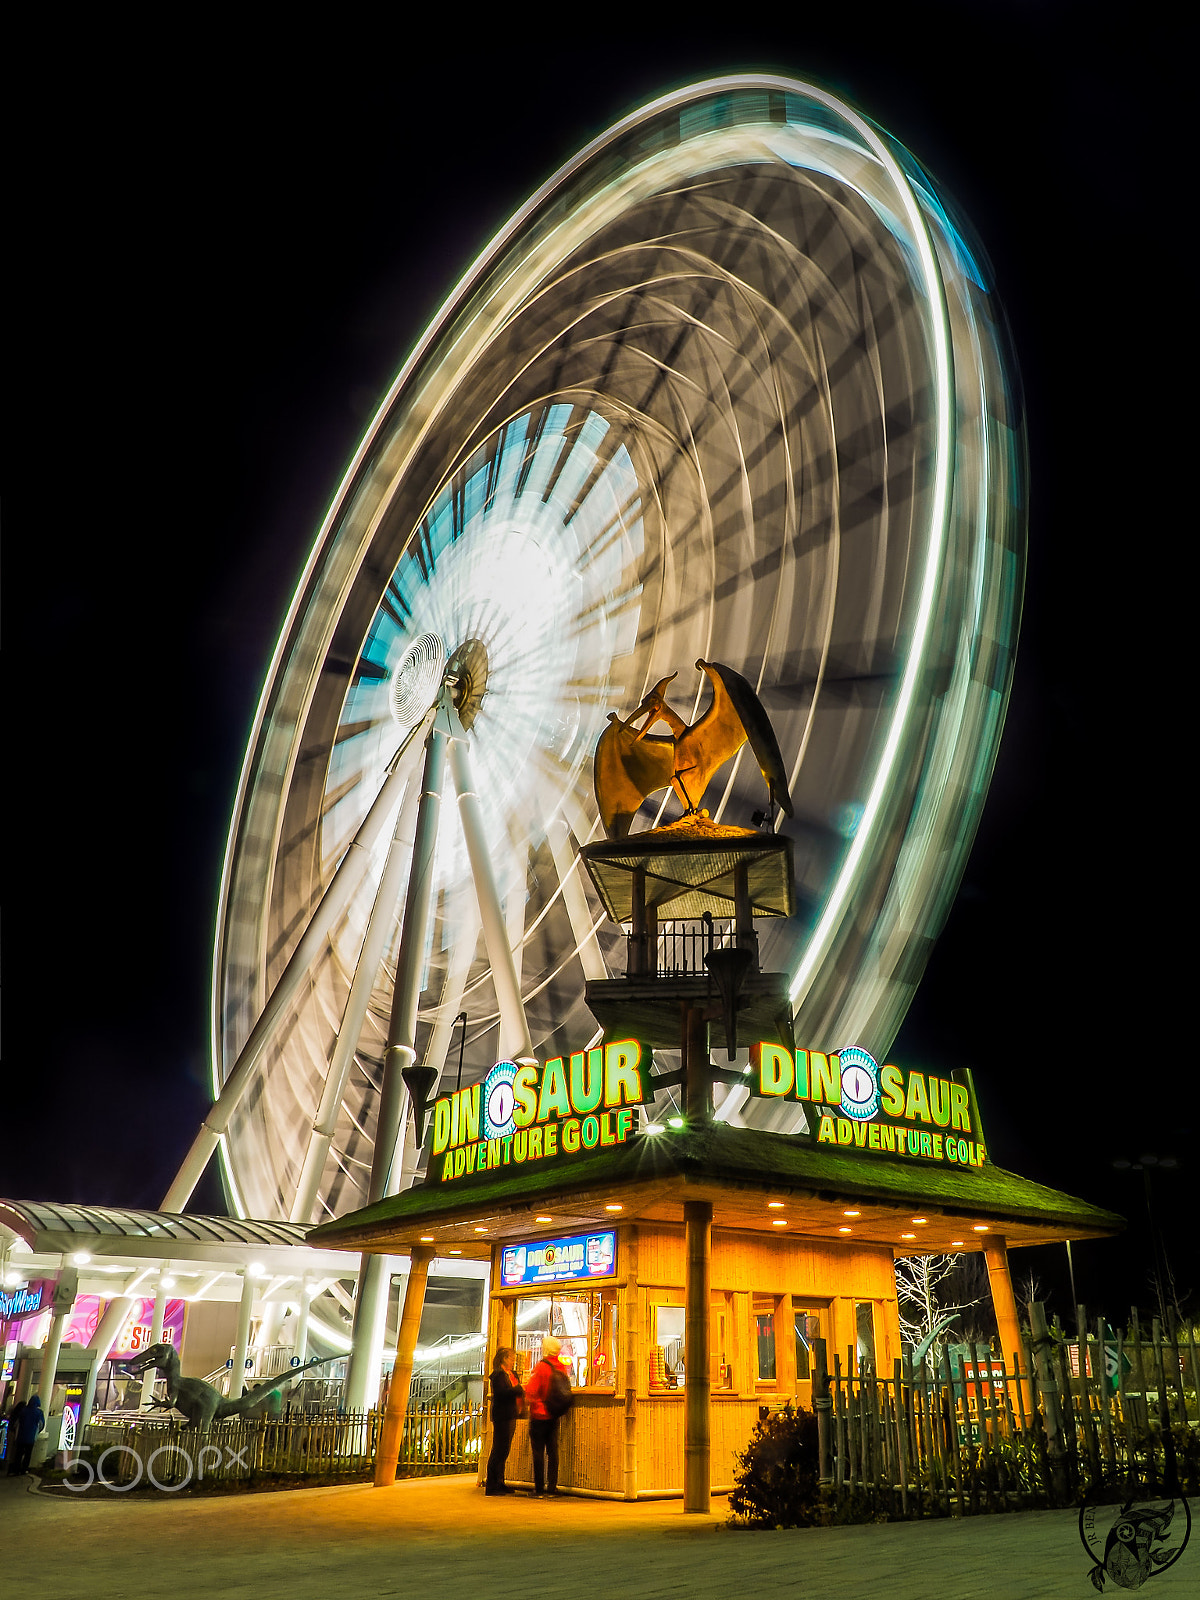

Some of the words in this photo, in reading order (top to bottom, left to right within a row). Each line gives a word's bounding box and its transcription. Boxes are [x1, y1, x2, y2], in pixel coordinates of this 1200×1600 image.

[433, 1038, 643, 1155] DINOSAUR
[759, 1041, 972, 1133] DINOSAUR
[441, 1122, 558, 1182] ADVENTURE
[562, 1108, 633, 1153] GOLF
[818, 1114, 944, 1160] ADVENTURE
[945, 1135, 986, 1167] GOLF
[527, 1243, 584, 1267] DINOSAUR
